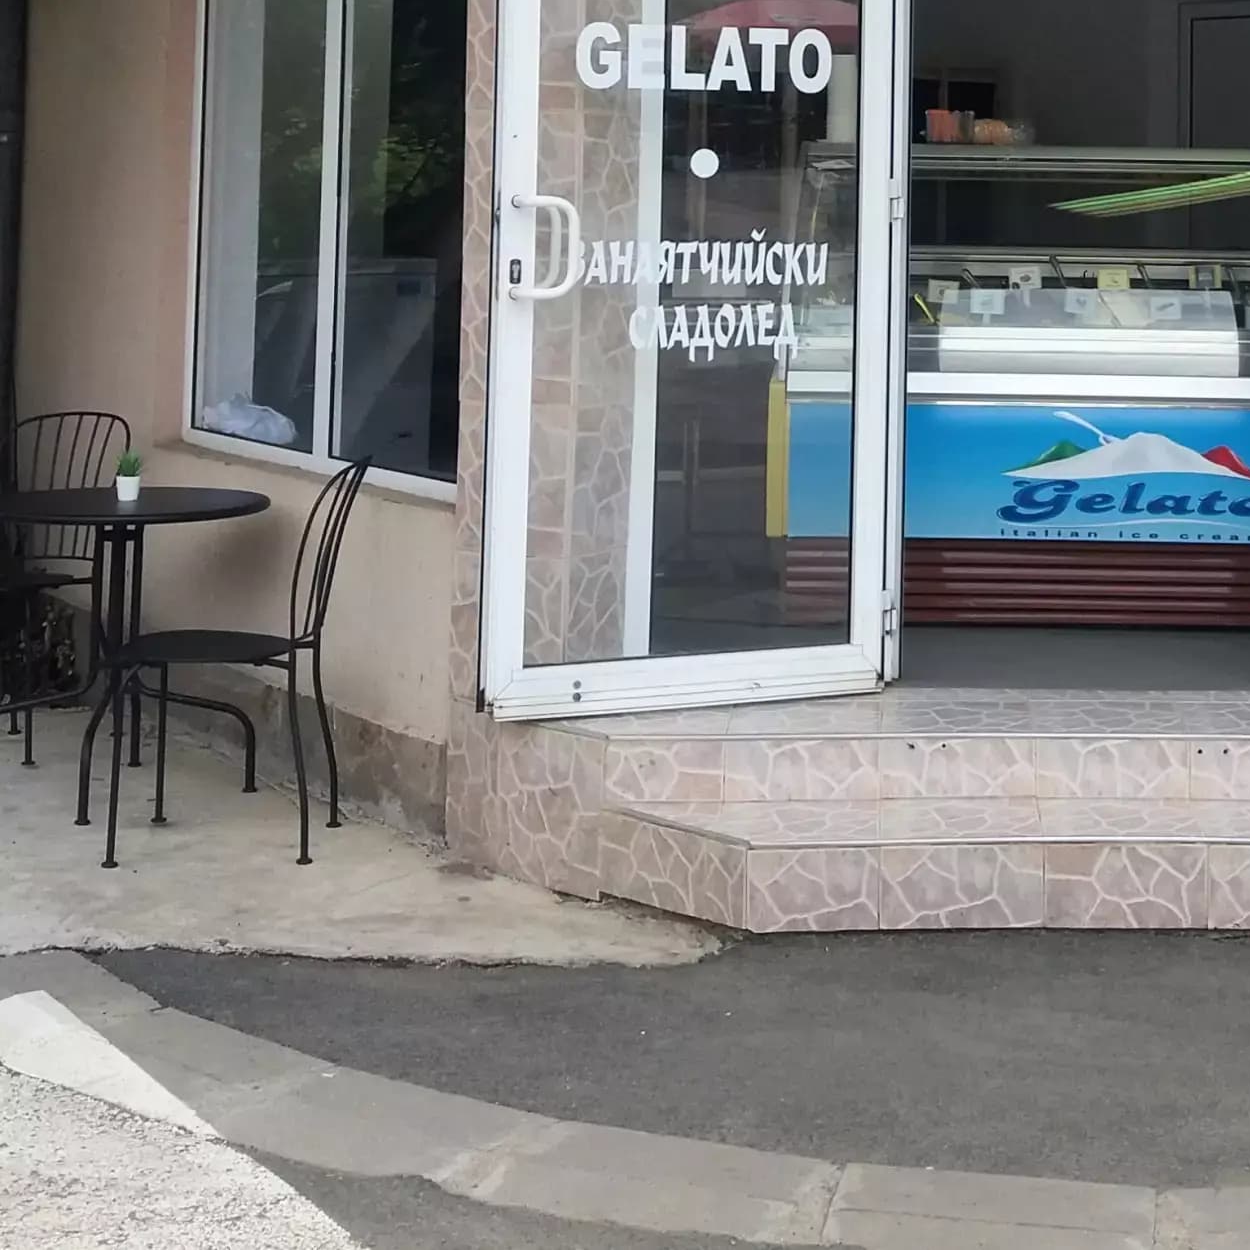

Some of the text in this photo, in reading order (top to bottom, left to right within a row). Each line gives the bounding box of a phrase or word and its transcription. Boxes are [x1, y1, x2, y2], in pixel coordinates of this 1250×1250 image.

[575, 21, 833, 94] GELATO
[629, 302, 800, 362] СЛАДОЛЕД
[1000, 528, 1098, 538] italian
[1119, 530, 1159, 539] ice
